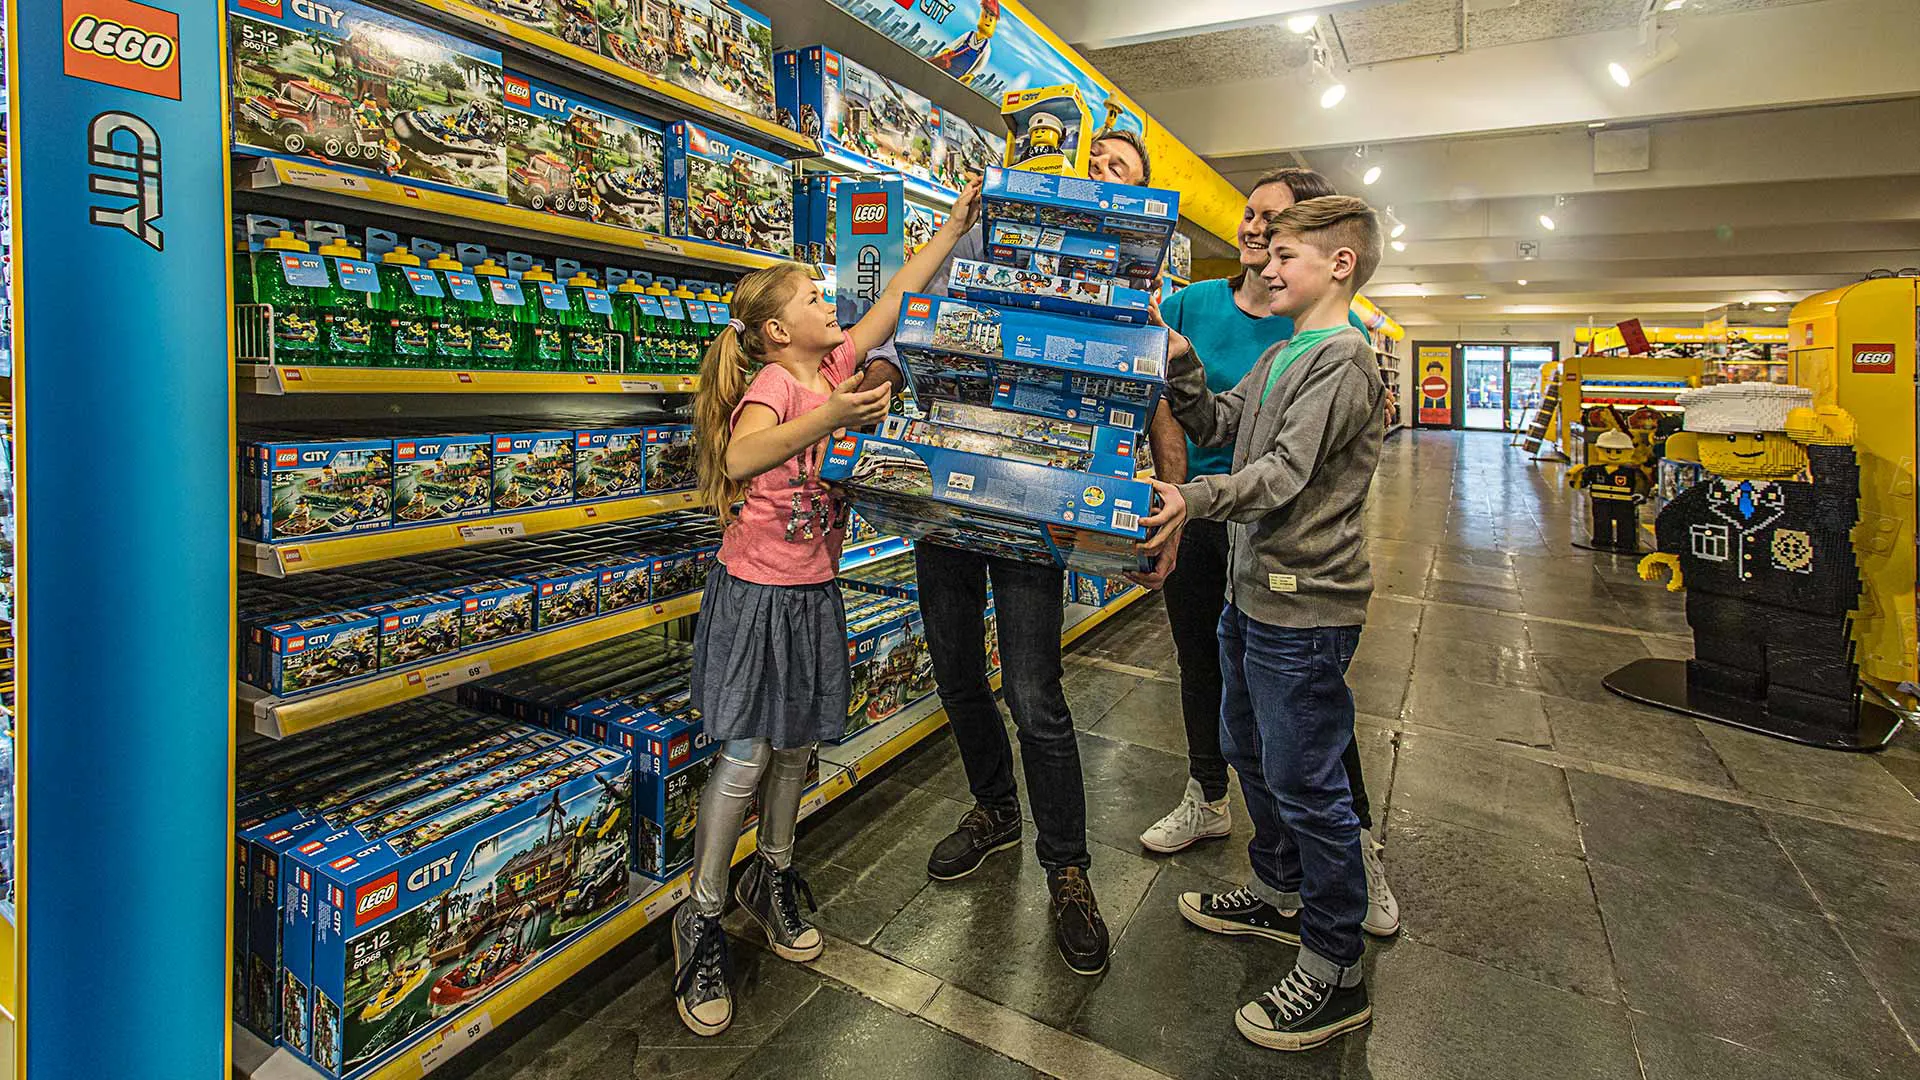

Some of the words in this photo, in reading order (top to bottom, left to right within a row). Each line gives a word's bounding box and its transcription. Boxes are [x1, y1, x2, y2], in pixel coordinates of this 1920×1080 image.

[291, 0, 344, 28] CITY
[69, 15, 175, 69] LEGO
[242, 24, 279, 46] 5-12
[243, 40, 269, 53] 60071
[507, 82, 529, 98] LEGO
[535, 91, 567, 113] CITY
[507, 114, 529, 129] 5-12
[710, 140, 730, 157] CITY
[1030, 164, 1063, 172] Policeman
[88, 110, 163, 252] CITY
[854, 204, 886, 222] LEGO
[356, 267, 372, 275] CITY
[858, 245, 880, 304] CITY
[1854, 352, 1893, 365] LEGO
[514, 440, 532, 449] CITY
[592, 434, 607, 443] CITY
[278, 454, 297, 463] LEGO
[302, 451, 330, 462] CITY
[419, 445, 441, 455] CITY
[276, 473, 295, 481] 5-12
[554, 583, 568, 591] CITY
[480, 597, 497, 606] CITY
[402, 614, 420, 624] CITY
[308, 633, 330, 645] CITY
[859, 637, 875, 653] CITY
[670, 740, 690, 760] LEGO
[669, 775, 688, 791] 5-12
[292, 819, 316, 831] CITY
[324, 829, 349, 842] CITY
[356, 844, 381, 858] CITY
[358, 882, 397, 914] LEGO
[406, 851, 458, 892] CITY
[301, 893, 309, 918] CITY
[333, 910, 341, 936] CITY
[354, 931, 390, 958] 5-12
[353, 950, 381, 969] 60068
